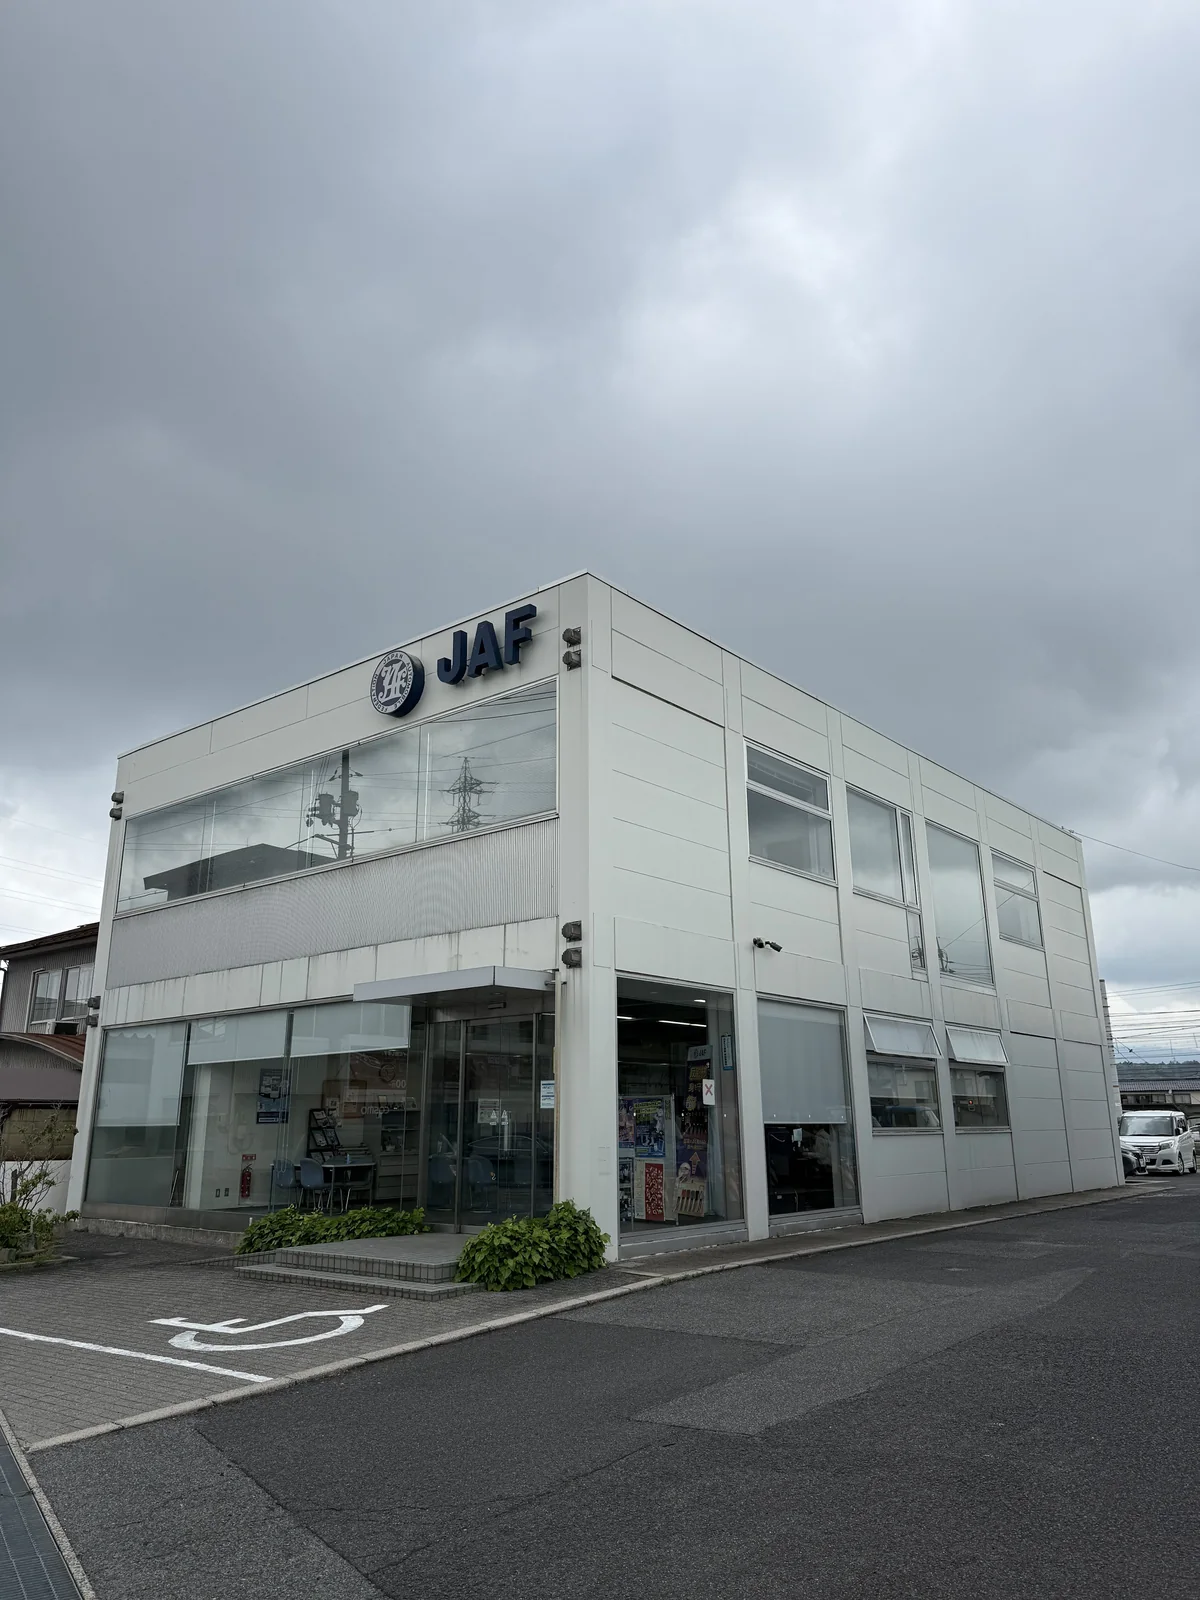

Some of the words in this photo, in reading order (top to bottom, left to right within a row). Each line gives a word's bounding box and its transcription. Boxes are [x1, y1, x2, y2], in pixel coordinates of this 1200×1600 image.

[382, 652, 405, 665] JAPAN
[437, 604, 537, 685] JAF
[393, 661, 413, 710] AUTOMOBILE
